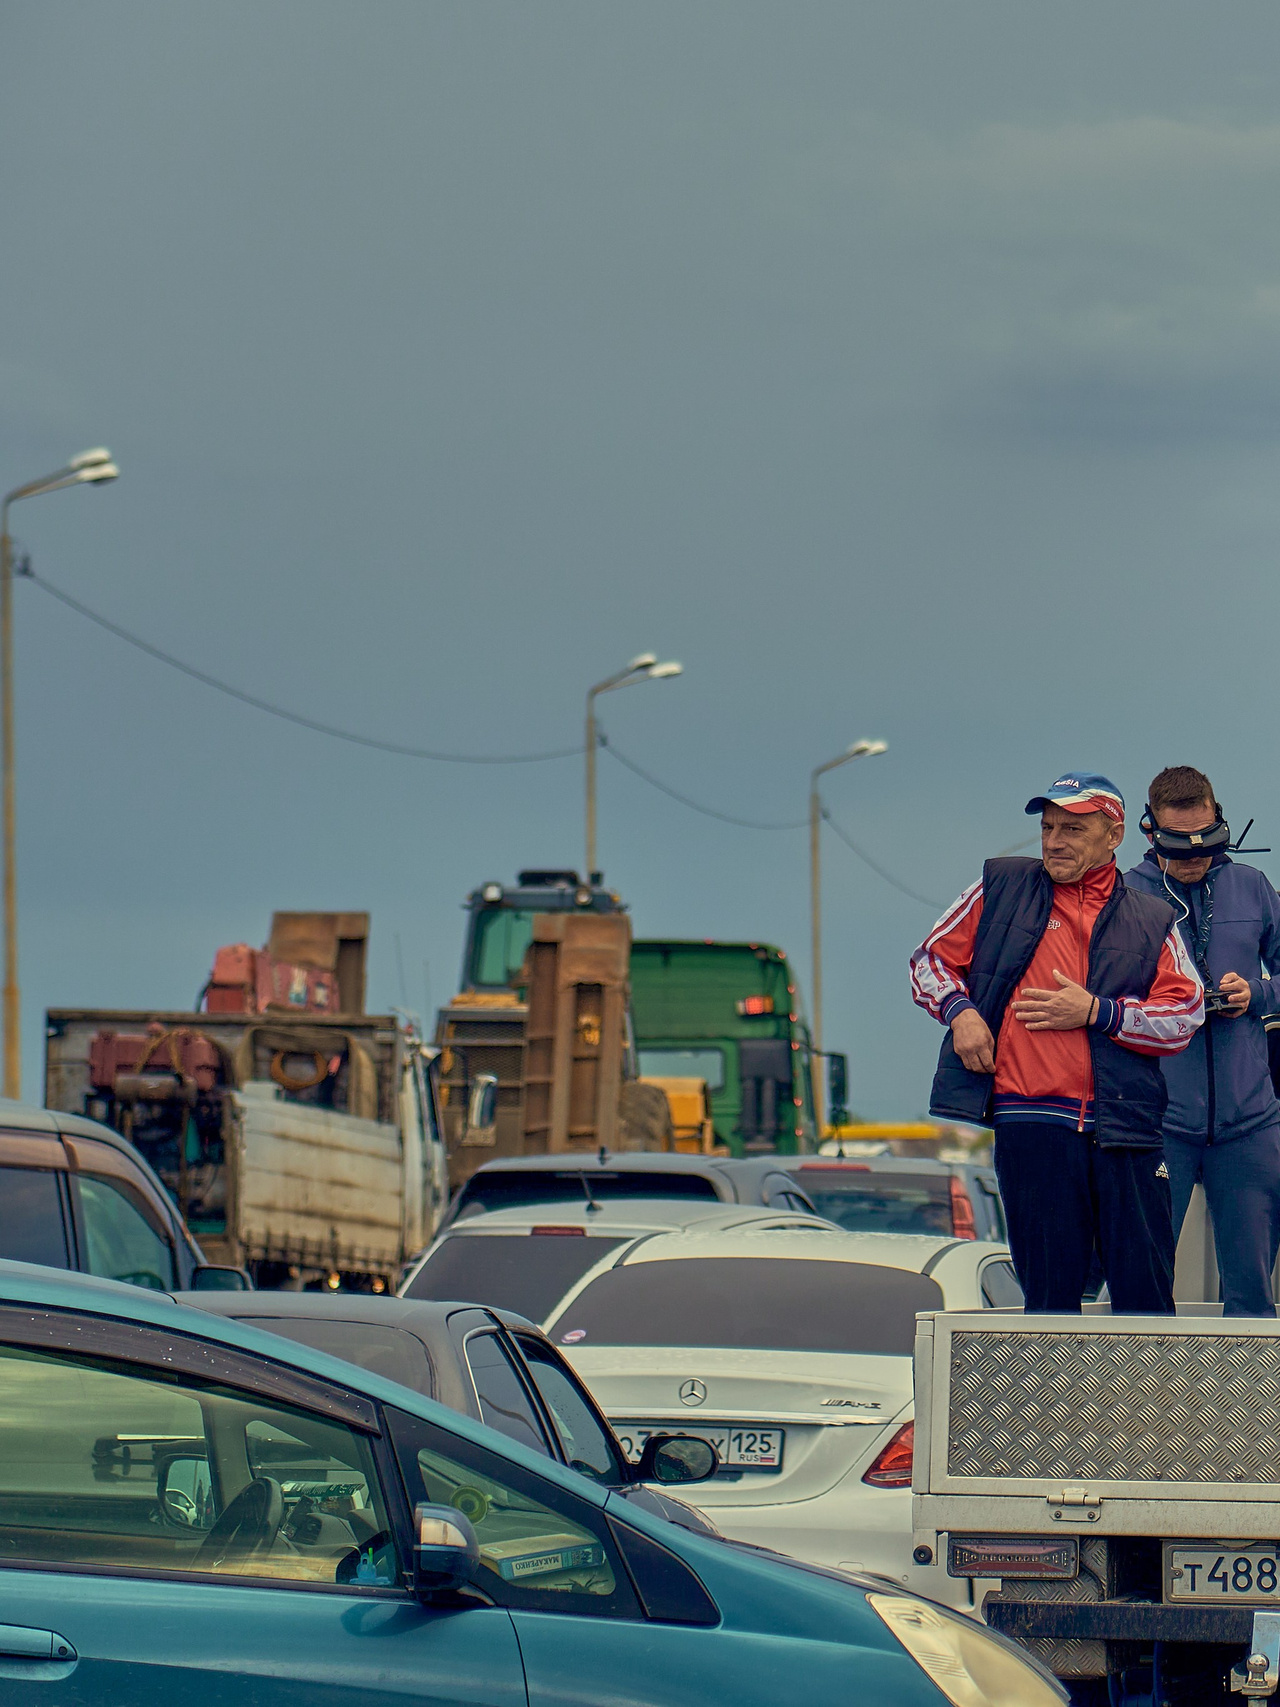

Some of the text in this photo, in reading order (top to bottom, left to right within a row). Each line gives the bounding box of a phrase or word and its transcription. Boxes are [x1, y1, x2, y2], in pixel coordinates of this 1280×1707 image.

[731, 1432, 772, 1454] 125
[739, 1453, 760, 1463] RUS
[515, 1555, 560, 1571] МАКАРЕНКО
